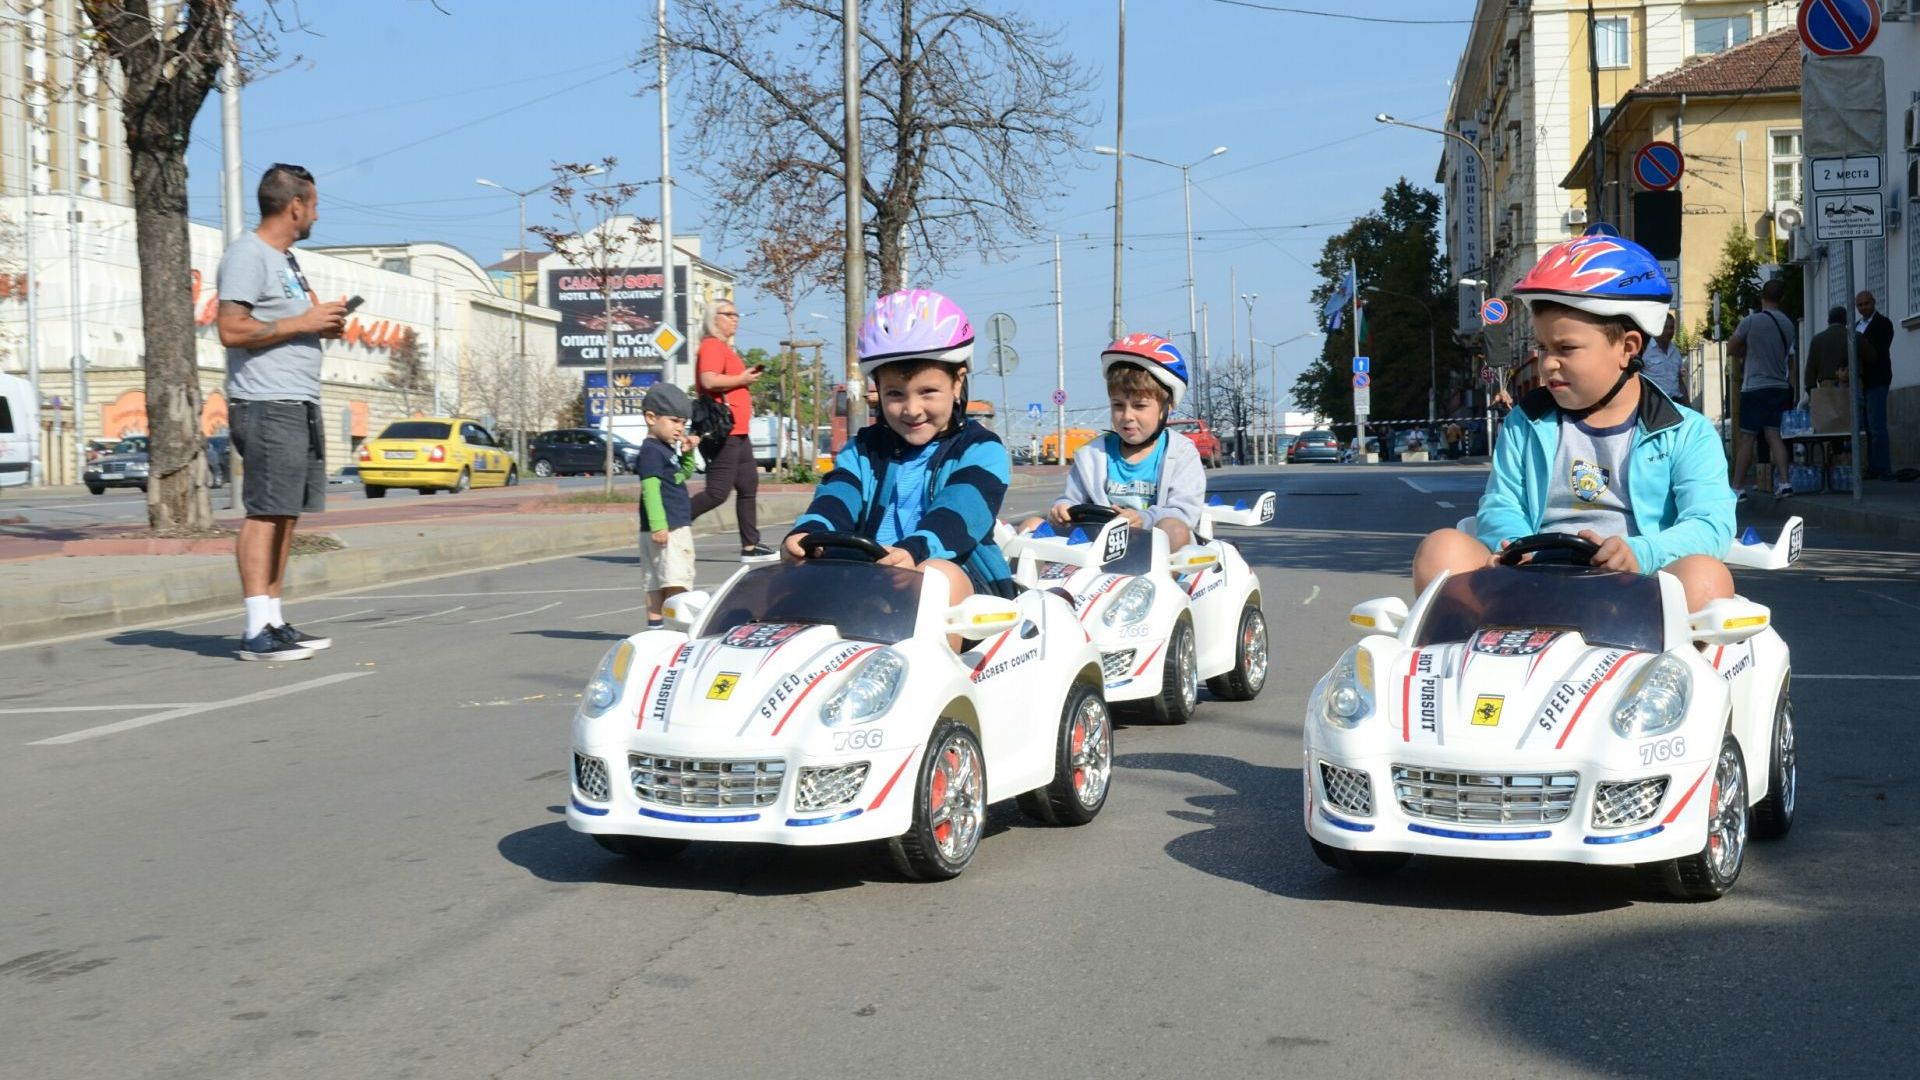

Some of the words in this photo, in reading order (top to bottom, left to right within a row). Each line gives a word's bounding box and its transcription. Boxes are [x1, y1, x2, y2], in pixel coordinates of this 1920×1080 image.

[1823, 169, 1831, 181] 2
[1836, 169, 1870, 180] места
[624, 273, 666, 289] SOFI
[580, 348, 599, 359] СИ
[677, 645, 695, 665] HOT
[1010, 648, 1039, 668] COUNTY
[1418, 653, 1434, 674] HOT
[653, 668, 678, 722] PURSUIT
[760, 674, 801, 719] SPEED
[1421, 679, 1436, 733] PURSUIT
[1539, 683, 1576, 732] SPEED
